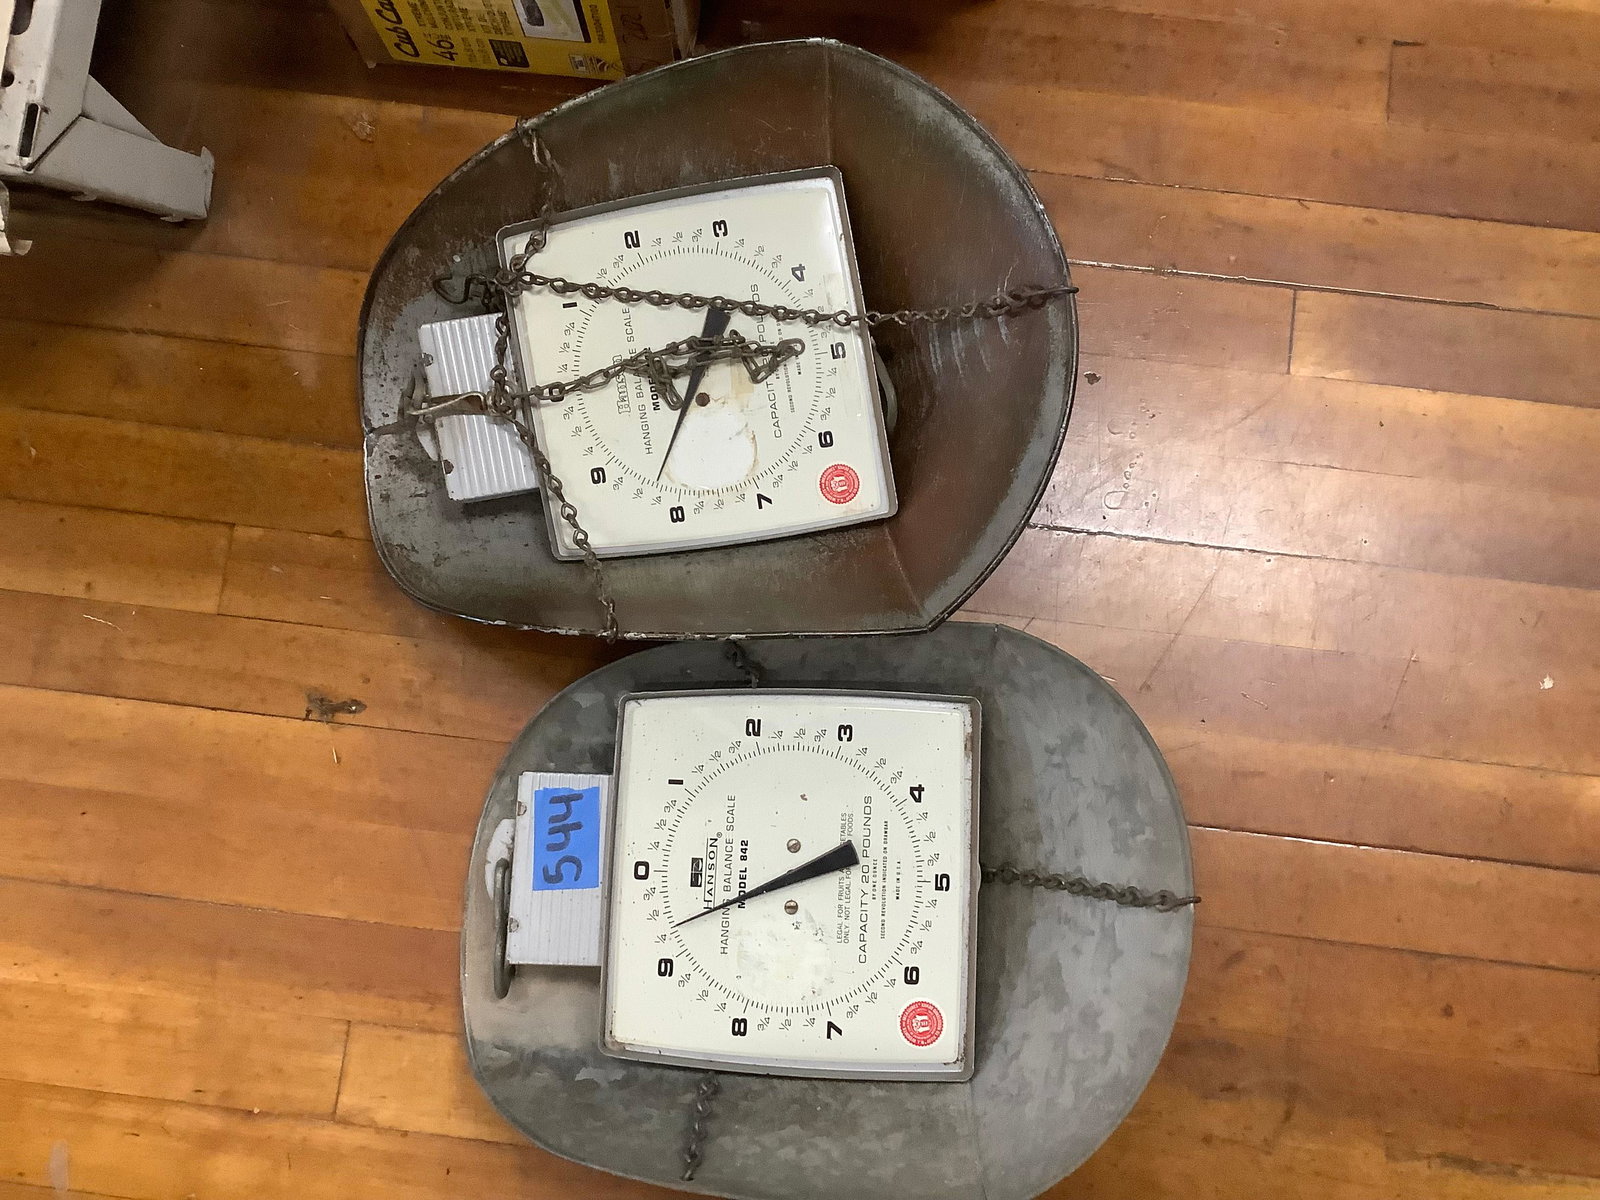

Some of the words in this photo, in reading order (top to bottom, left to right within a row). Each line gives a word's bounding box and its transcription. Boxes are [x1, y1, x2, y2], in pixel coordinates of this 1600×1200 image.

[385, 26, 420, 58] Cub
[426, 39, 458, 61] 46
[713, 220, 728, 238] 3
[624, 230, 641, 249] 2
[791, 264, 806, 282] 4
[622, 308, 634, 342] SCALE
[831, 342, 846, 359] 5
[612, 354, 631, 414] Hansn
[766, 381, 782, 438] CAPACIT
[638, 404, 653, 454] HANGING
[818, 431, 833, 448] 6
[591, 467, 606, 484] 9
[757, 493, 772, 509] 7
[670, 506, 685, 523] 8
[746, 719, 761, 736] 2
[838, 724, 852, 741] 3
[910, 784, 925, 803] 4
[726, 795, 735, 831] SCALE
[862, 796, 872, 858] POUNDS
[542, 792, 584, 884] 544
[740, 840, 748, 861] 842
[634, 861, 649, 880] 0
[723, 838, 734, 892] BALANCE
[862, 865, 869, 883] 20
[935, 874, 950, 891] 5
[859, 889, 868, 963] CAPACITY
[658, 958, 673, 977] 9
[904, 966, 919, 985] 6
[732, 1018, 747, 1036] 8
[827, 1021, 842, 1040] 7
